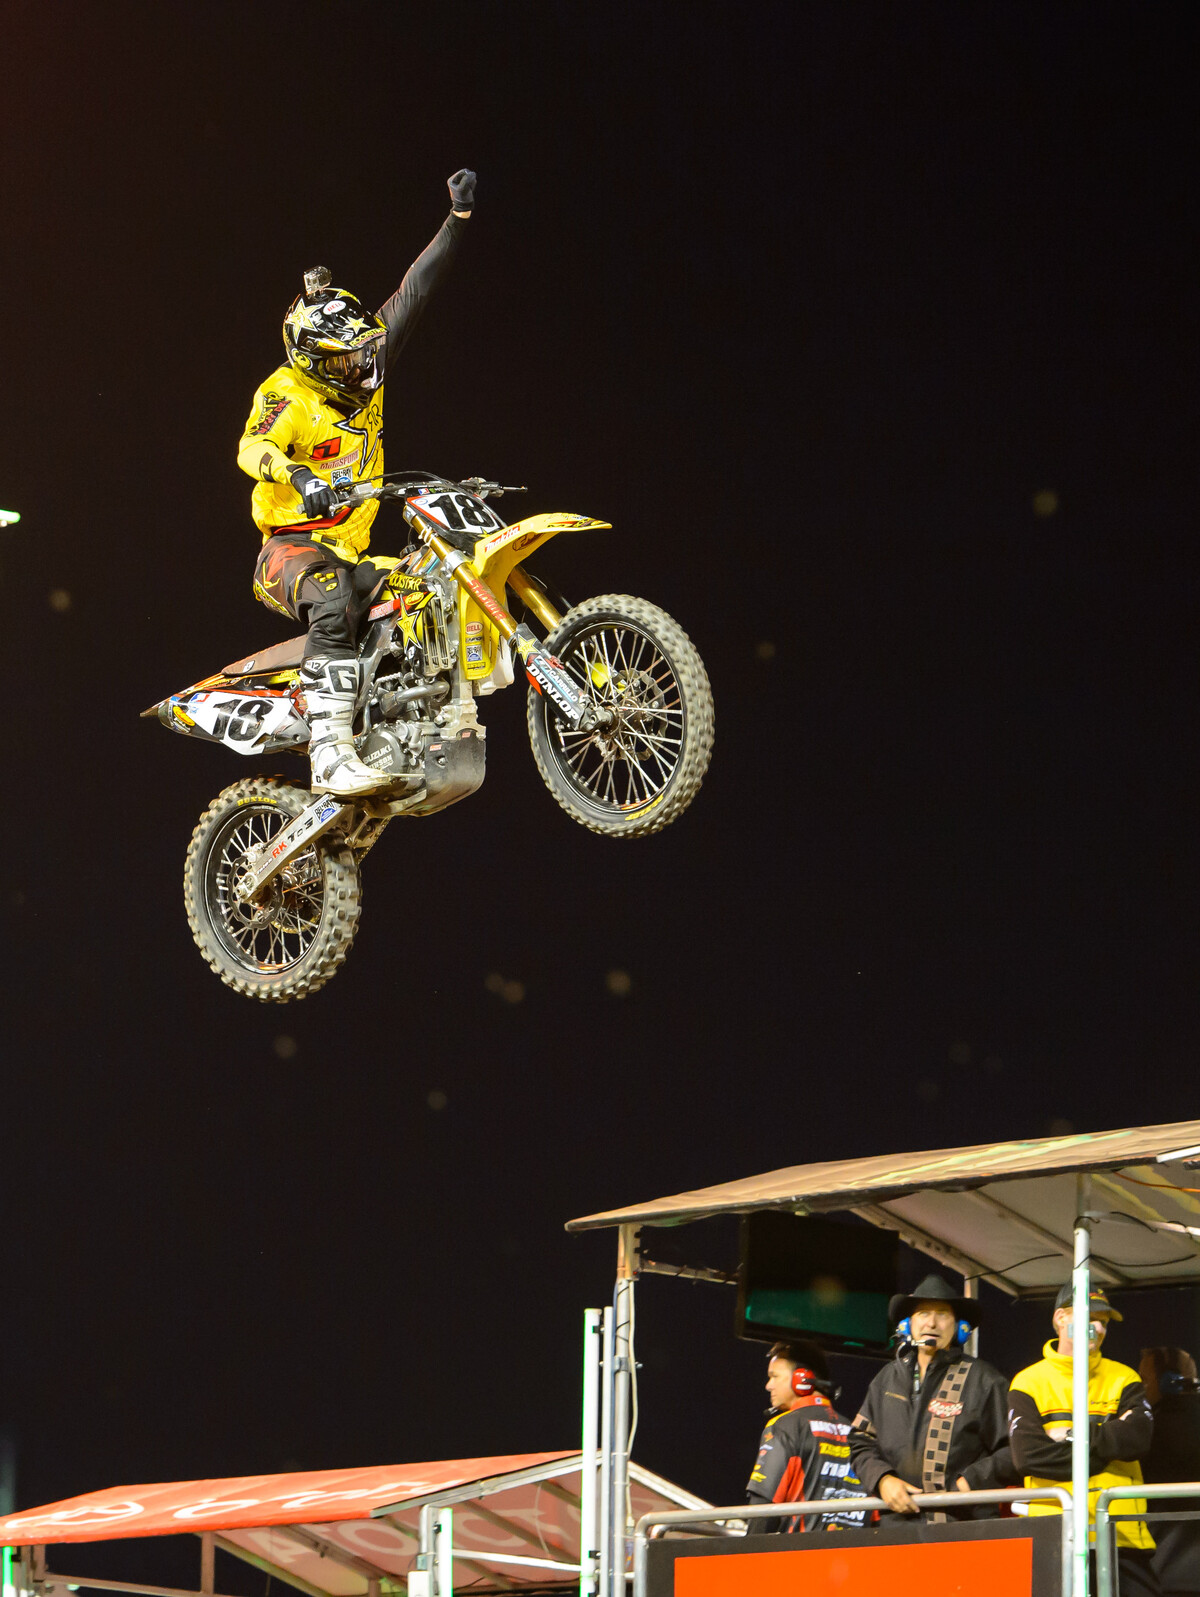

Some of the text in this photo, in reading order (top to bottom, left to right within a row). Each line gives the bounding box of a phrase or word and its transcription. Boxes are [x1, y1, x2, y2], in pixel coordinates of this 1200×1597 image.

[428, 494, 495, 530] 18
[526, 663, 580, 720] DUNLOP
[213, 699, 274, 742] 18
[362, 744, 393, 764] SUZUKI
[237, 796, 277, 806] DUNLOP
[272, 841, 288, 858] RK
